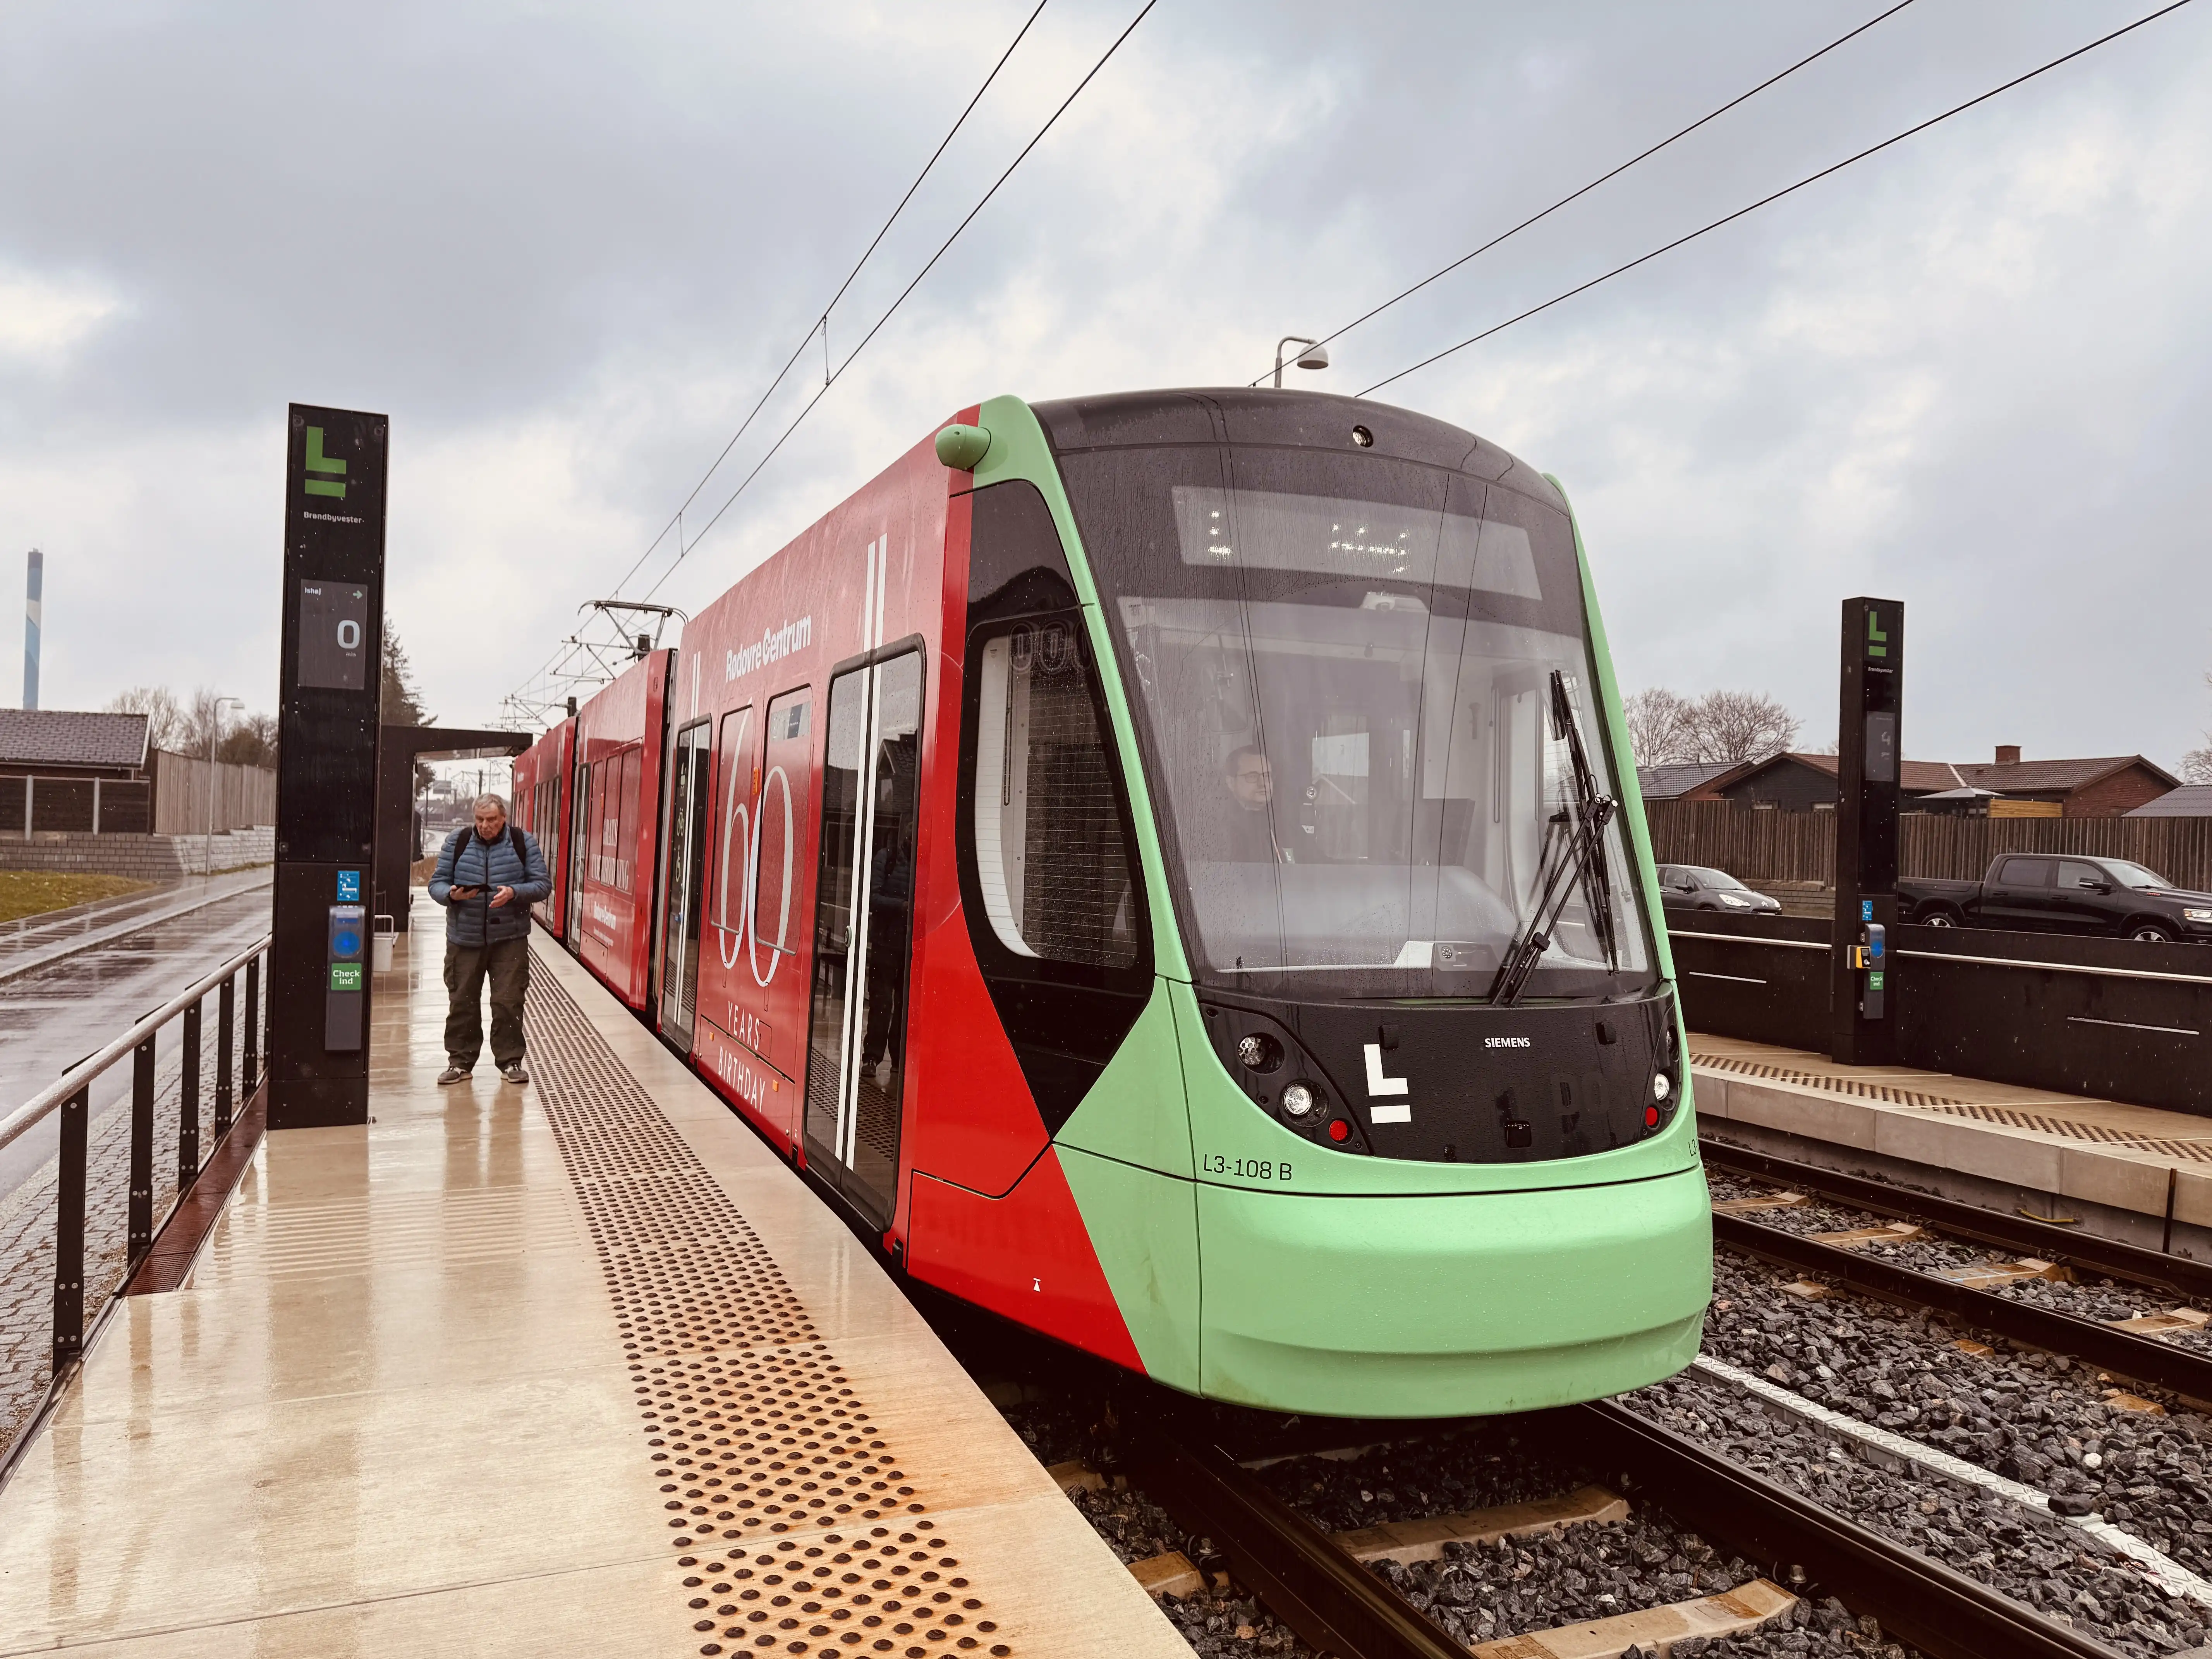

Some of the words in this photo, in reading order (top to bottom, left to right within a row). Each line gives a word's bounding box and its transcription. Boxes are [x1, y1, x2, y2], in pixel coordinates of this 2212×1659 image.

[337, 620, 360, 649] 0
[721, 696, 793, 987] 60
[728, 1000, 759, 1051] YEARS
[1485, 1037, 1530, 1048] SIEMENS
[718, 1046, 766, 1113] BIRTHDAY
[1204, 1154, 1272, 1179] L3-108
[1280, 1163, 1292, 1180] B
